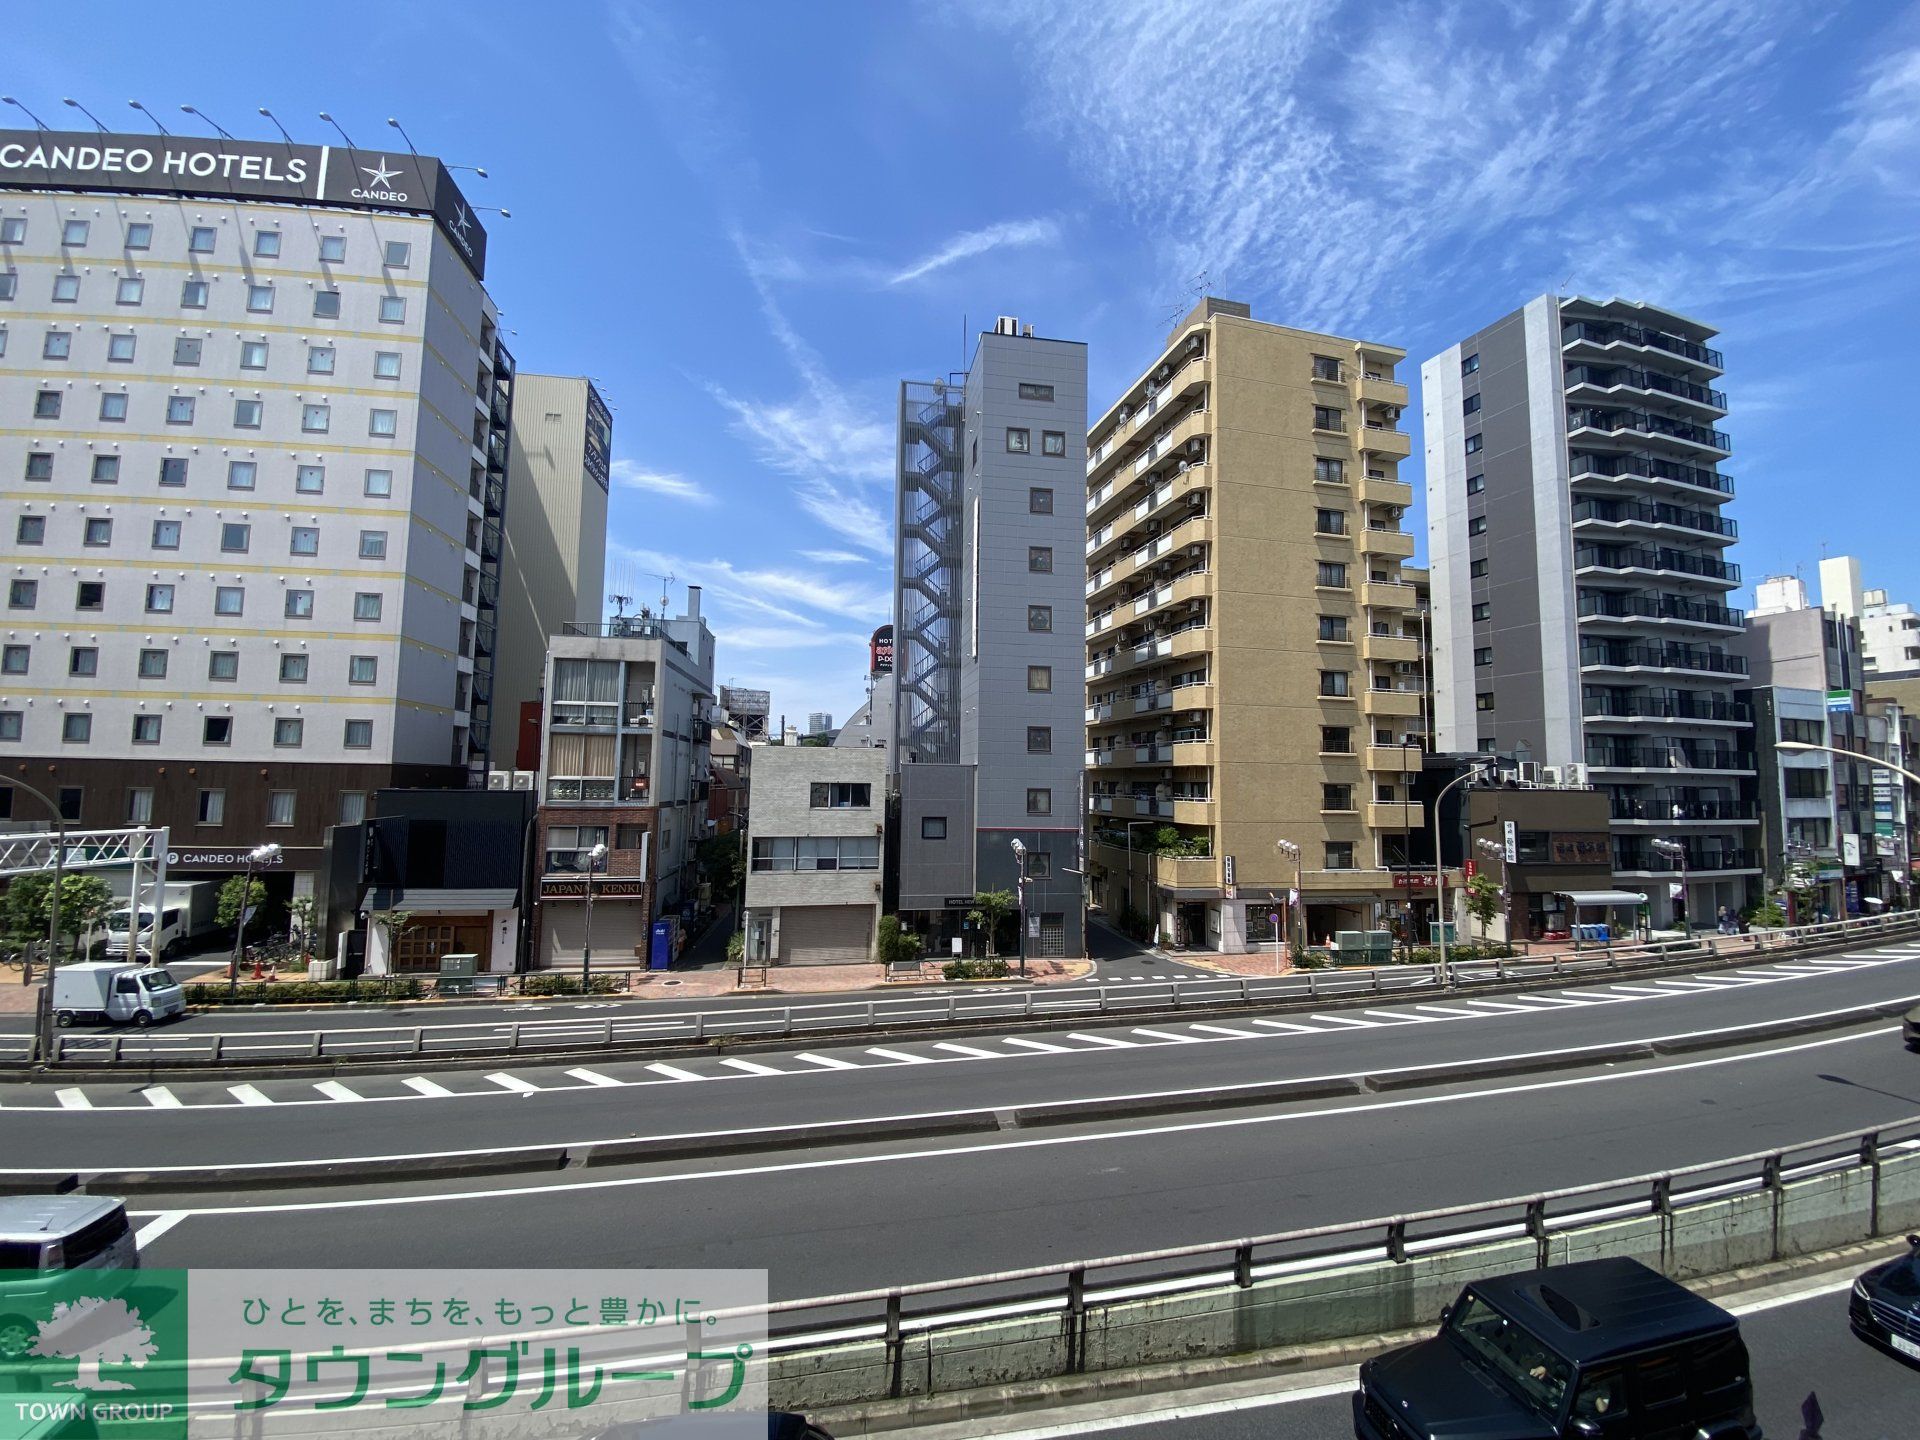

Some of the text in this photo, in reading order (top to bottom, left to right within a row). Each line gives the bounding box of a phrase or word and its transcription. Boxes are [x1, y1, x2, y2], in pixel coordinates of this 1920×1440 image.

[0, 144, 307, 183] CANDEO HOTELS
[351, 188, 408, 202] CANDEO
[449, 219, 473, 257] CANDEO
[183, 854, 234, 863] CANDEO
[237, 854, 283, 864] HOS
[543, 884, 640, 894] JAPAN KENKI
